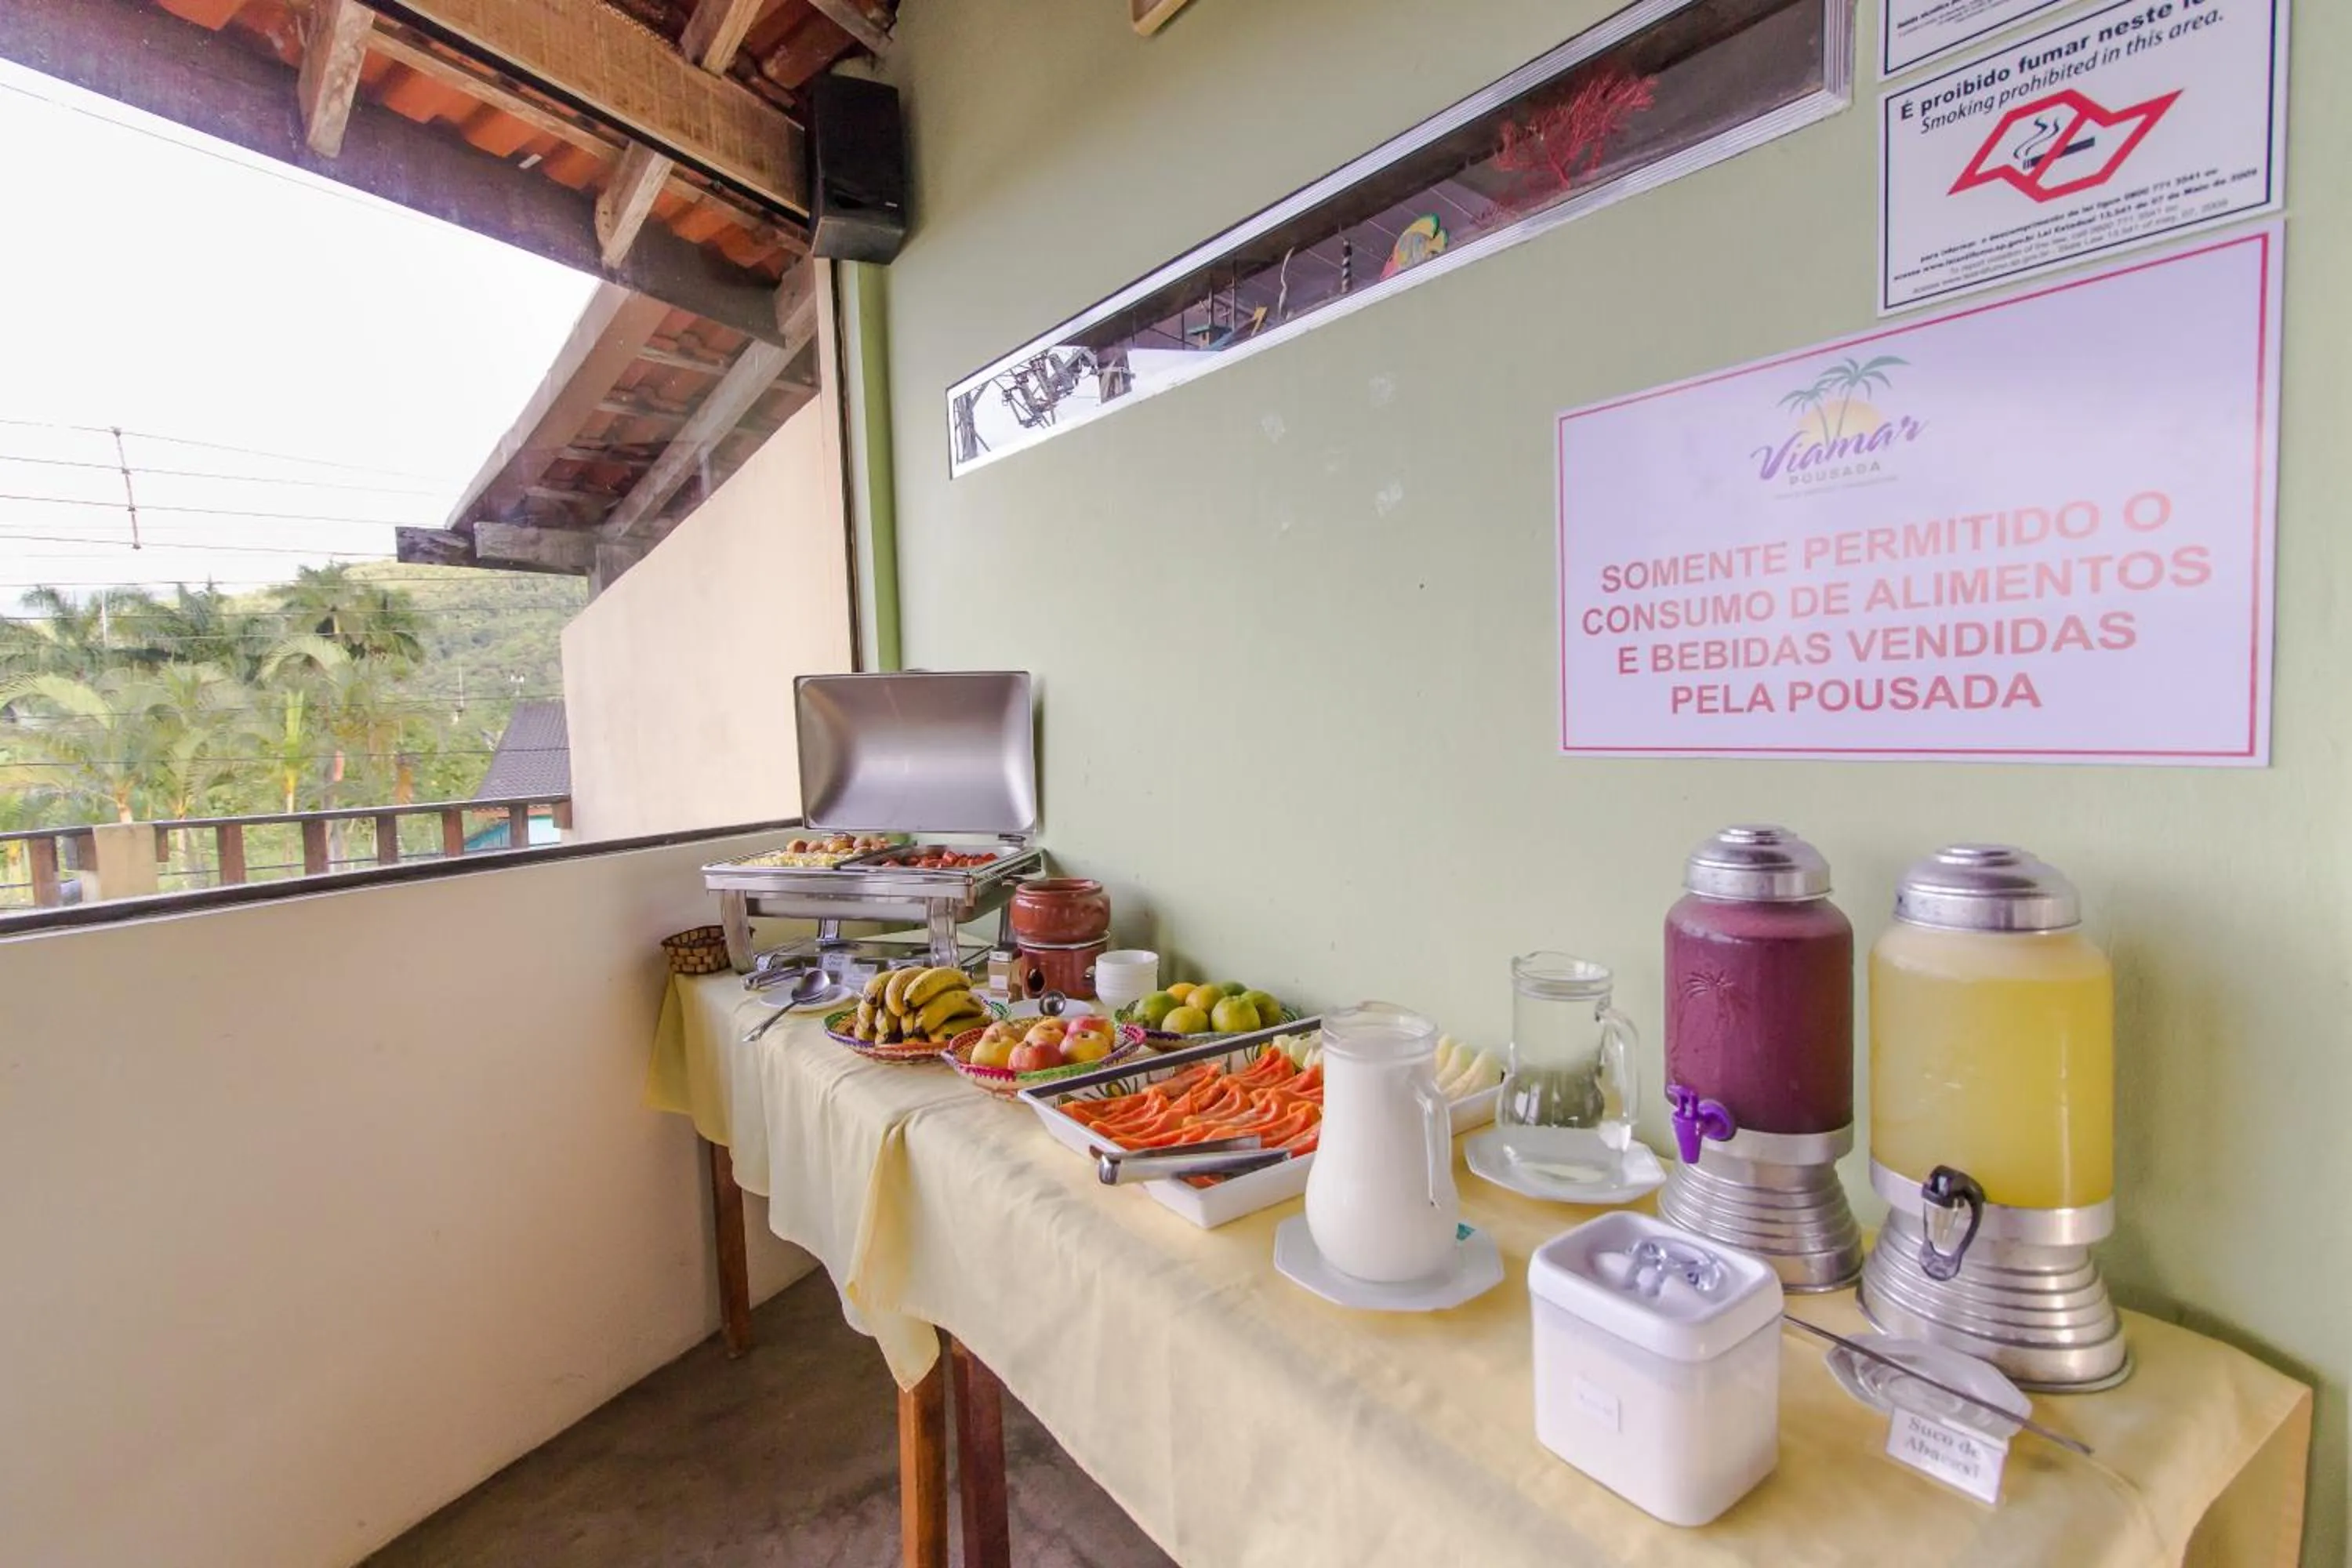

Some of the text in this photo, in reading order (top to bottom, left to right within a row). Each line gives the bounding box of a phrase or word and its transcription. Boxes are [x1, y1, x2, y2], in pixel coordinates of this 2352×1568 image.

[1901, 3, 2172, 120] É proibido fumar neste
[1922, 9, 2223, 134] Smoking prohibited in this area.
[1750, 416, 1929, 480] Viamar
[1788, 461, 1880, 485] POUSADA
[1601, 491, 2172, 594] SOMENTE PERMITIDO O
[1582, 545, 2212, 636] CONSUMO DE ALIMENTOS
[1618, 612, 2137, 674] E BEBIDAS VENDIDAS
[1671, 673, 2042, 715] PELA POUSADA
